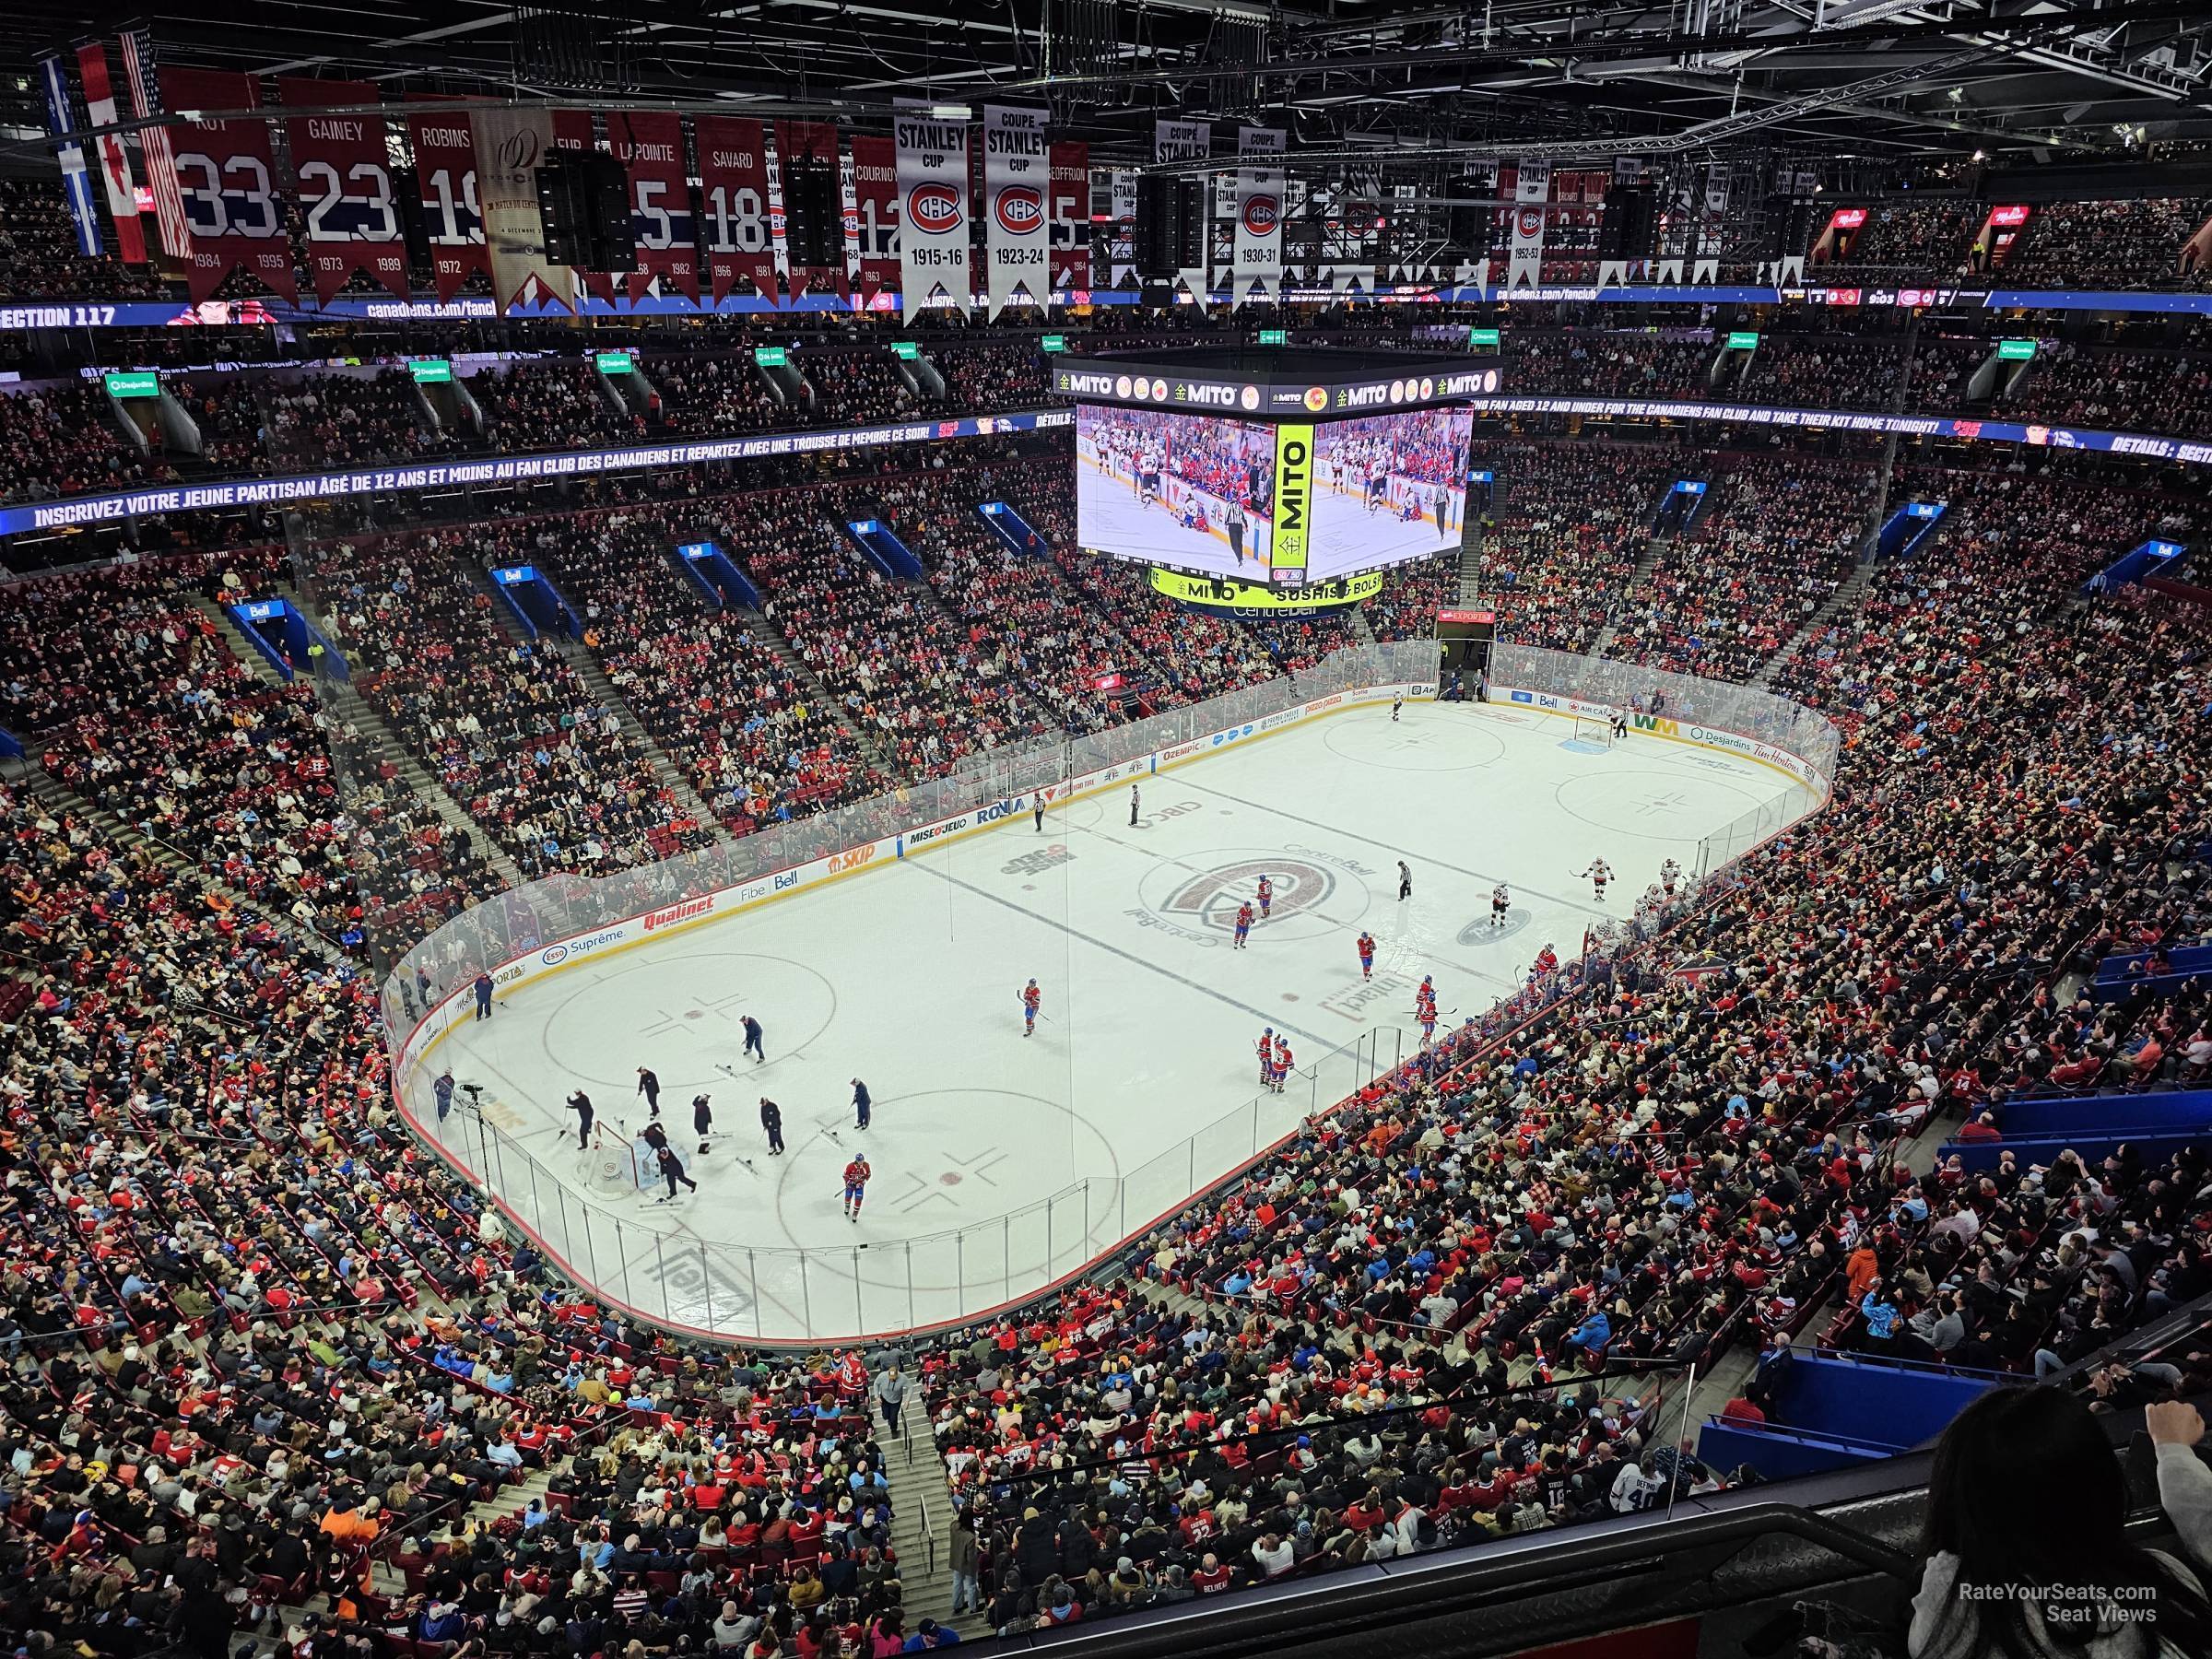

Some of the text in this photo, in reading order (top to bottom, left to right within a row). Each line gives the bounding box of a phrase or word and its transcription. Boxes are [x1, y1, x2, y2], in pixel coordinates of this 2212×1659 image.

[1001, 112, 1035, 127] COUPE
[308, 118, 363, 142] GAINEY
[898, 124, 965, 151] STANLEY
[1171, 127, 1197, 141] COUPE
[988, 128, 1049, 156] STANLEY
[1250, 133, 1275, 147] COUPE
[619, 141, 675, 162] LAPOINTE
[713, 150, 753, 170] SAVARD
[923, 154, 944, 168] CUP
[1009, 159, 1030, 172] CUP
[1254, 172, 1269, 183] CUP
[1519, 166, 1548, 183] STANLEY
[175, 153, 278, 238] 33
[1527, 185, 1538, 195] CUP
[299, 161, 397, 242] 23
[635, 181, 674, 250] 5
[709, 186, 767, 253] 18
[1055, 196, 1077, 251] 5
[194, 253, 285, 268] 1984 1995
[912, 248, 962, 265] 1915-16
[995, 248, 1044, 265] 1923-24
[1242, 248, 1276, 263] 1930-31
[1515, 247, 1539, 260] 1952-53
[319, 257, 401, 271] 1973 1989
[438, 261, 461, 274] 1972
[672, 263, 690, 275] 1982
[714, 265, 771, 277] 1966 1981
[1074, 262, 1087, 271] 1964
[865, 271, 880, 281] 1963
[1869, 294, 1894, 305] 9:03
[75, 307, 116, 326] 117
[421, 367, 447, 375] Desjardins
[121, 381, 154, 389] Desjardins
[1071, 375, 1112, 394] MITO
[1437, 374, 1481, 395] 金 MITO
[1174, 382, 1235, 406] 金 MITO
[1279, 394, 1301, 402] MITO
[1336, 385, 1387, 407] 金 MITO
[1489, 400, 1939, 434] FAN AGED 12 AND UNDER FOR THE CANADIENS FAN CLUB AND TAKE THEIR KIT HOME TONIGHT!
[1953, 419, 1983, 437] $35
[34, 426, 930, 527] INSCRIVEZ VOTRE JEUNE PARTISAN ÂGÉ DE 12 ANS ET MOINS AU FAN CLUB DES CANADIENS ET REPARTEZ AVEC UNE TROUSSE DE MEMBRE CE SOIR!
[1471, 472, 1484, 480] Bell
[1280, 441, 1306, 530] MITO
[984, 504, 995, 514] Bell
[1918, 507, 1933, 515] Bell
[856, 522, 868, 533] Bell
[688, 546, 702, 557] Bell
[2159, 545, 2173, 557] Bell
[504, 570, 523, 582] Bell
[1276, 571, 1300, 580] 50/50
[1354, 577, 1377, 594] BOLS
[250, 605, 269, 618] Bell
[1453, 612, 1481, 620] EXPORT
[1305, 696, 1342, 715] pizza pizza
[1540, 695, 1558, 709] Bell
[1634, 713, 1680, 736] WM
[1706, 731, 1751, 751] Desjardins
[1753, 743, 1771, 760] Tim
[1771, 748, 1799, 774] Hortons
[1147, 800, 1203, 822] CIBC
[842, 844, 875, 870] SKIP
[1283, 843, 1377, 877] CentreBell
[775, 871, 798, 891] Bell
[741, 886, 766, 902] Fibe
[643, 895, 715, 932] Qualinet
[1598, 927, 1610, 938] 28
[571, 929, 625, 953] Suprême
[1956, 1078, 1970, 1091] 14
